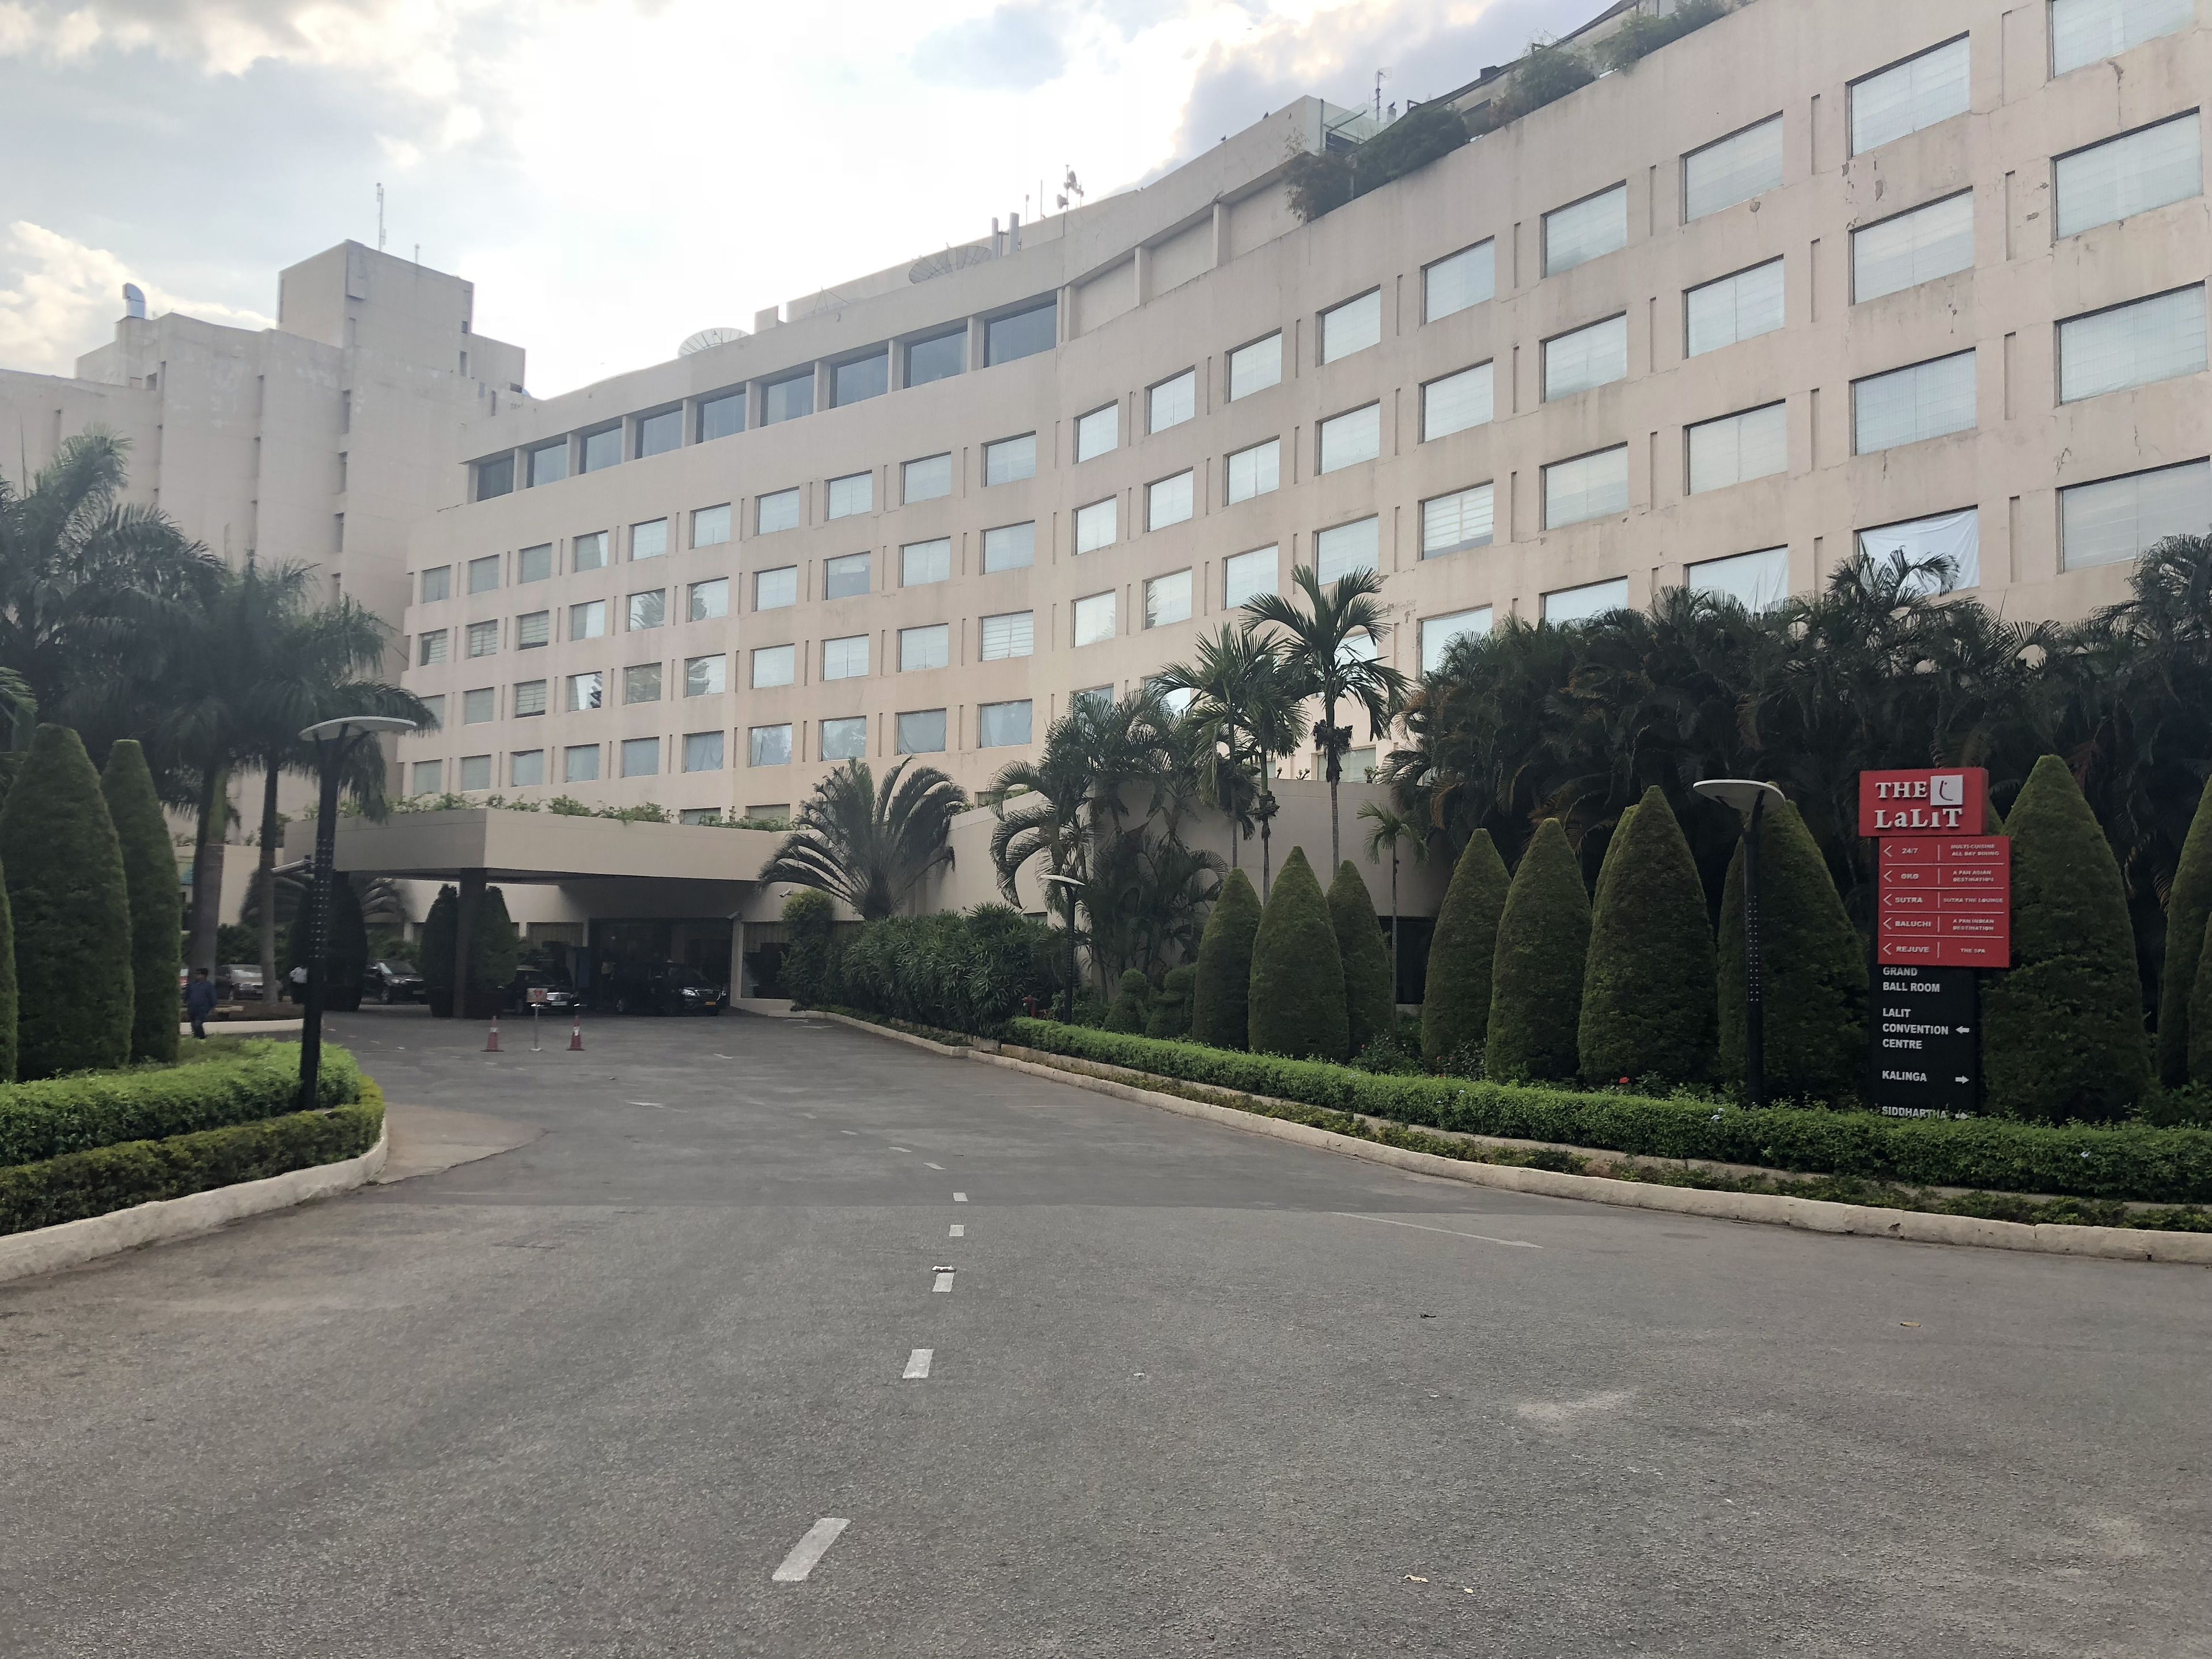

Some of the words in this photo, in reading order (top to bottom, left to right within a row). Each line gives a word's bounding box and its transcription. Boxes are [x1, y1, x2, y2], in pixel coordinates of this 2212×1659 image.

[1874, 781, 1928, 799] THE
[1883, 967, 1918, 976] GRAND
[1883, 982, 1908, 991] BALL
[1910, 982, 1941, 993] ROOM
[1882, 1007, 1911, 1018] LALIT
[1882, 1023, 1949, 1035] CONVENTION
[1882, 1039, 1923, 1050] CENTRE
[1881, 1070, 1927, 1082] KALINGA
